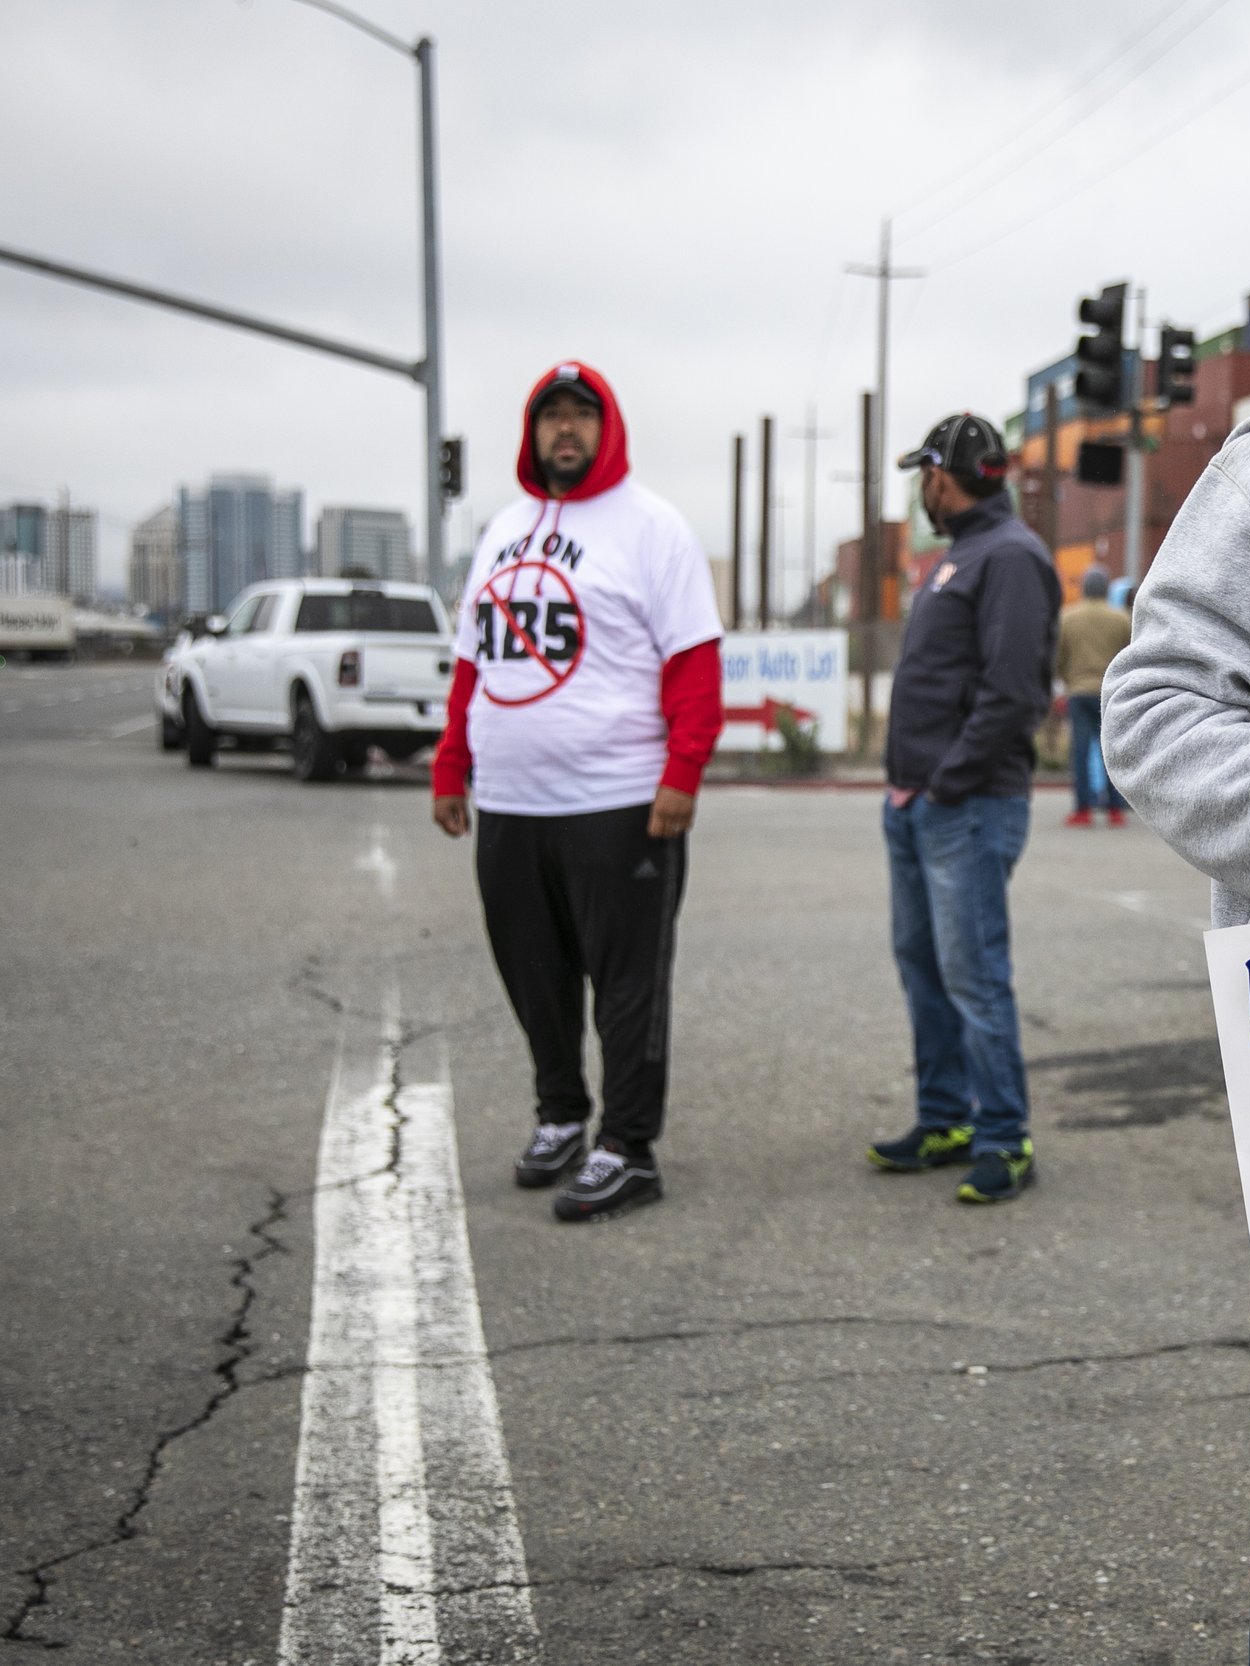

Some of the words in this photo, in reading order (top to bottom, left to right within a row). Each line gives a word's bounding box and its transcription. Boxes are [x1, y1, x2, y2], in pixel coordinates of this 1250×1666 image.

[489, 534, 532, 574] NO
[542, 532, 582, 570] ON
[476, 601, 580, 661] AB5
